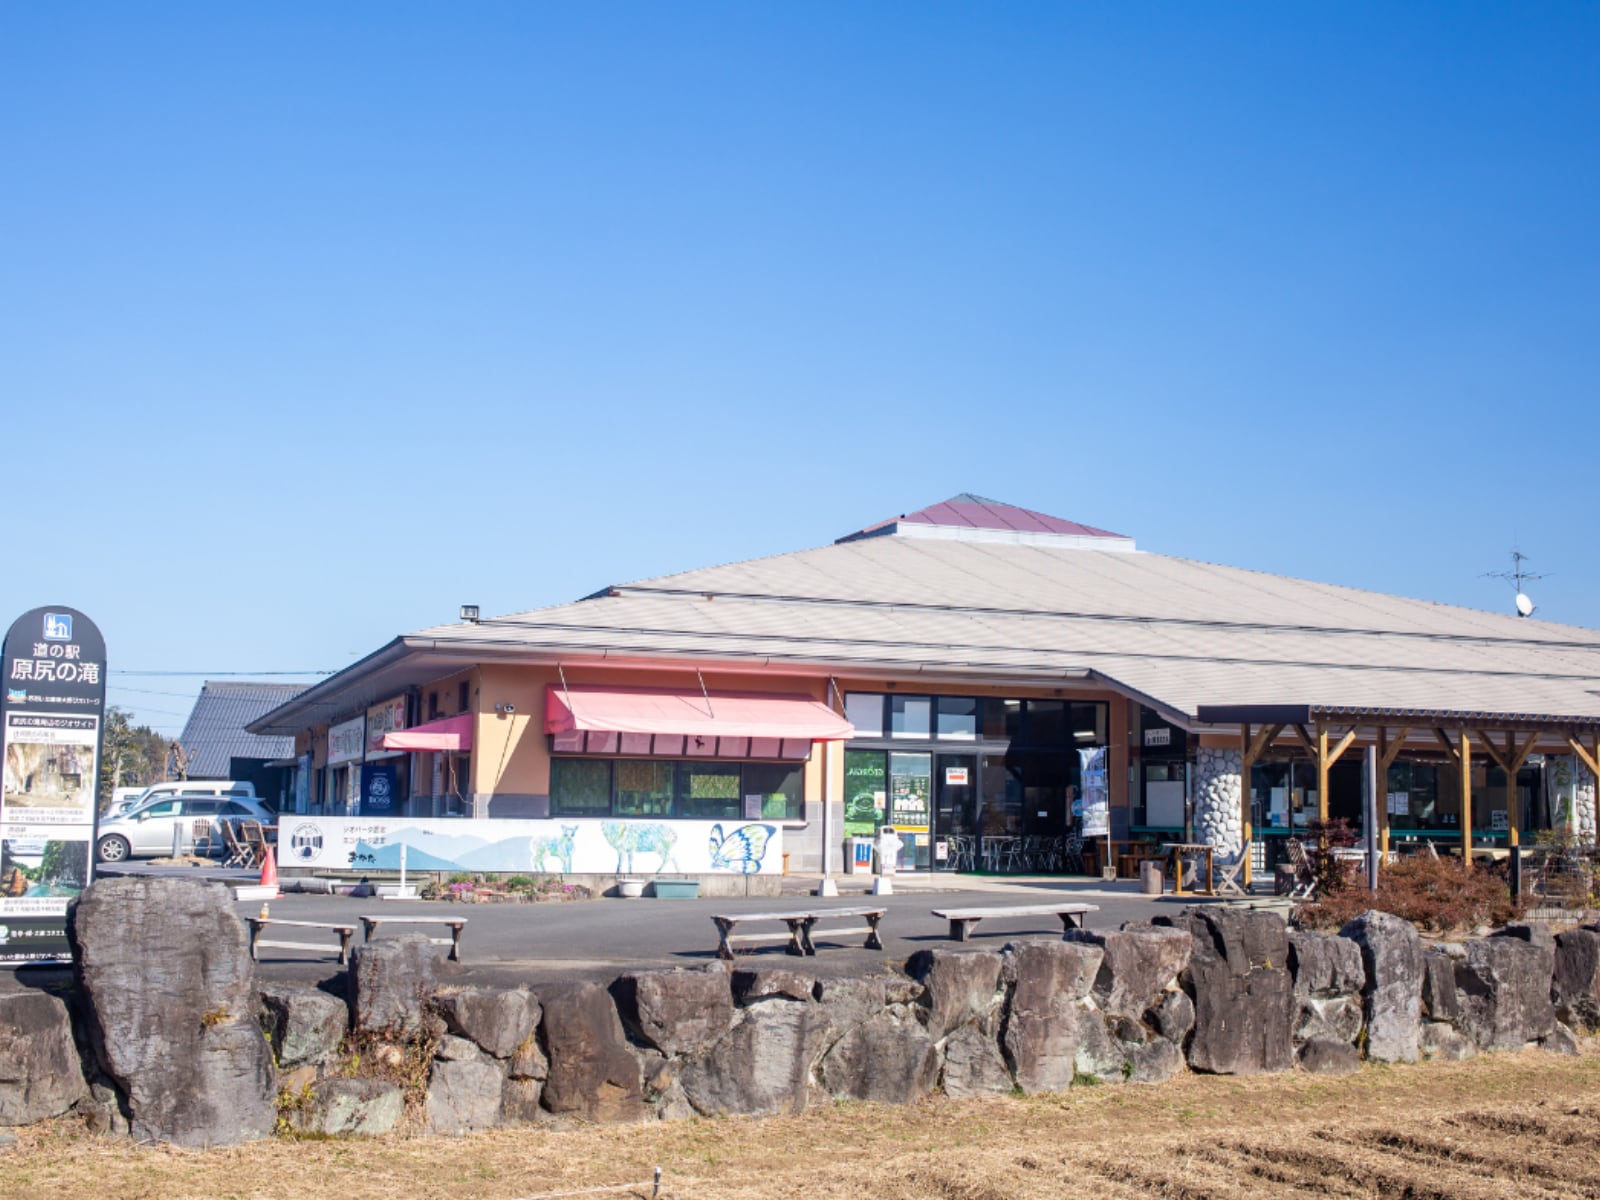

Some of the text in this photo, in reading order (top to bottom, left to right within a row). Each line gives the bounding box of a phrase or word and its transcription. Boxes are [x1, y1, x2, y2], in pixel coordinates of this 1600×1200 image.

[33, 643, 80, 660] 道の駅
[11, 659, 100, 684] 原尻の滝
[368, 796, 391, 804] BOSS
